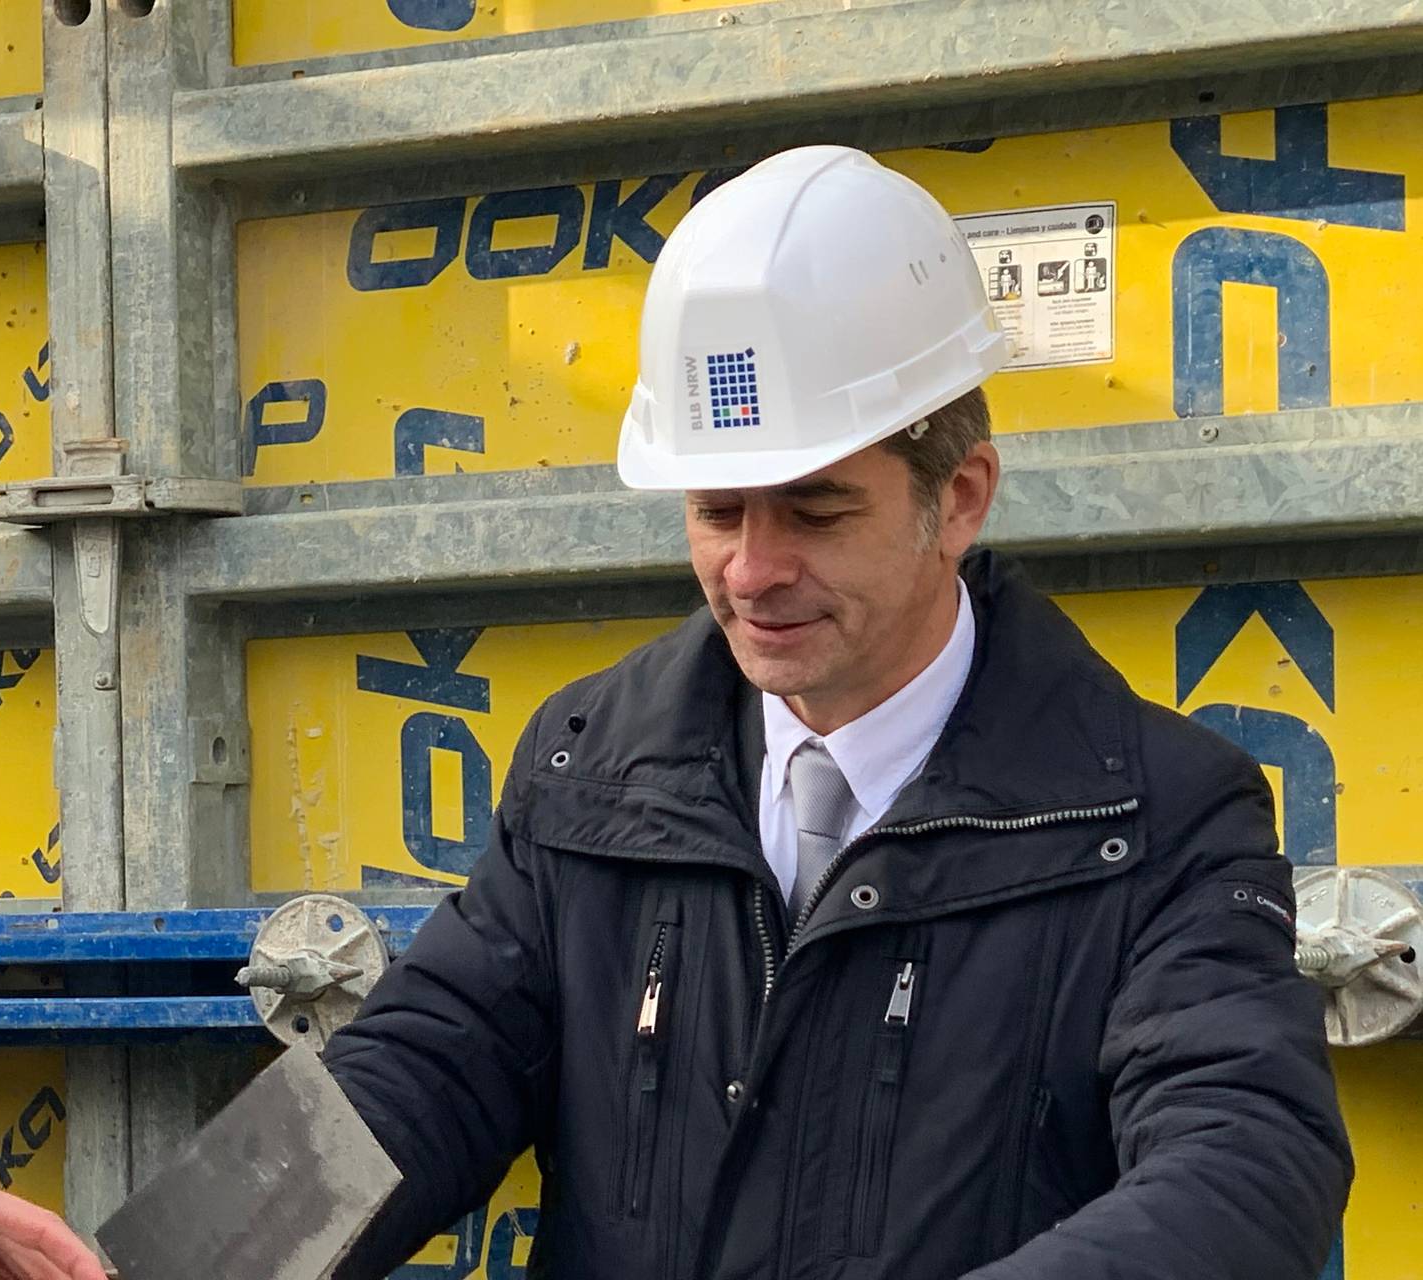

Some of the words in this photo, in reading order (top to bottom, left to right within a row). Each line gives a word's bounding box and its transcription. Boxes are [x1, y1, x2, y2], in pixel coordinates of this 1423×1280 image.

[346, 170, 717, 292] dok
[983, 230, 998, 238] care
[684, 355, 699, 397] NRW
[690, 402, 703, 431] BLB
